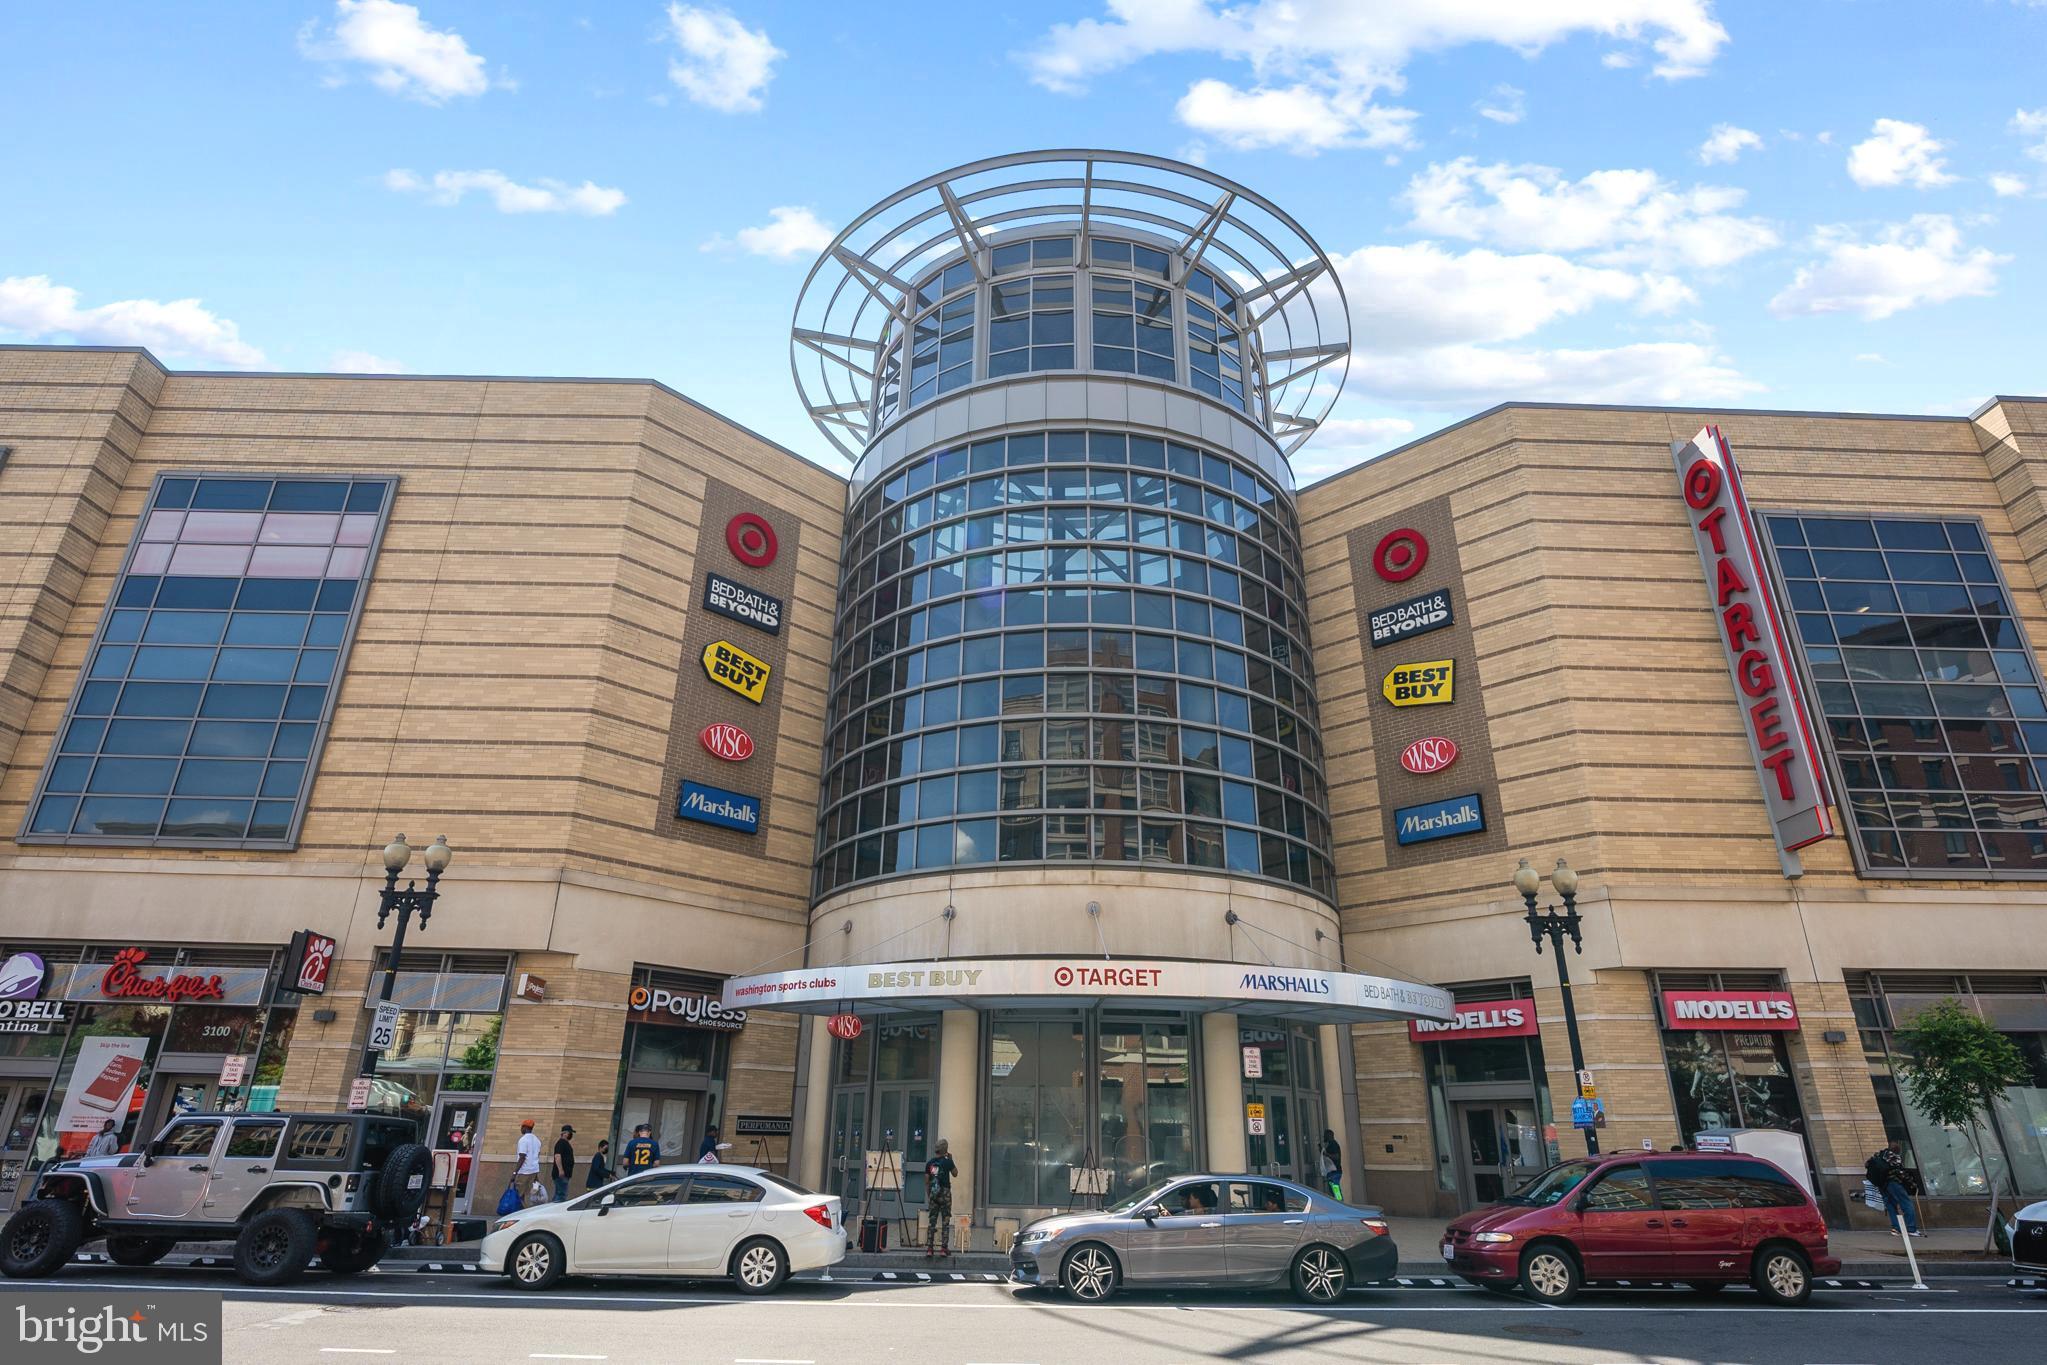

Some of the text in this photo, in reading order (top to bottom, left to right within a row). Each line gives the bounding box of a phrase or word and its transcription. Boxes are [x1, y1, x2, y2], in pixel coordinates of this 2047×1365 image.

[712, 579, 779, 617] BED BATH &
[710, 593, 778, 626] BEYOND
[1371, 595, 1446, 629] BED BATH &
[1373, 610, 1448, 641] BEYOND
[1699, 506, 1795, 800] TARGET
[715, 646, 767, 681] BEST
[713, 663, 759, 691] BUY
[1393, 667, 1450, 685] BEST
[1395, 683, 1443, 700] BUY
[710, 725, 748, 757] WSC
[1406, 740, 1449, 770] WSC
[683, 792, 756, 823] Marshalls
[1401, 806, 1479, 835] Marshalls
[736, 977, 836, 996] washington sports clubs
[868, 970, 982, 988] BEST BUY
[1077, 968, 1162, 987] TARGET
[1240, 974, 1328, 994] MARSHALLS
[1364, 984, 1380, 999] BED
[1380, 986, 1399, 1000] BATH
[1406, 991, 1446, 1009] BEYOND
[15, 1001, 65, 1019] BELL
[379, 1006, 397, 1015] SPEED
[379, 1015, 393, 1023] LIMIT
[1674, 1000, 1794, 1019] MODELL'S
[202, 1026, 231, 1036] 3100
[374, 1027, 391, 1045] 25
[836, 1017, 859, 1037] WSC
[740, 1121, 789, 1130] PERFUMANIA
[634, 1149, 650, 1165] 12
